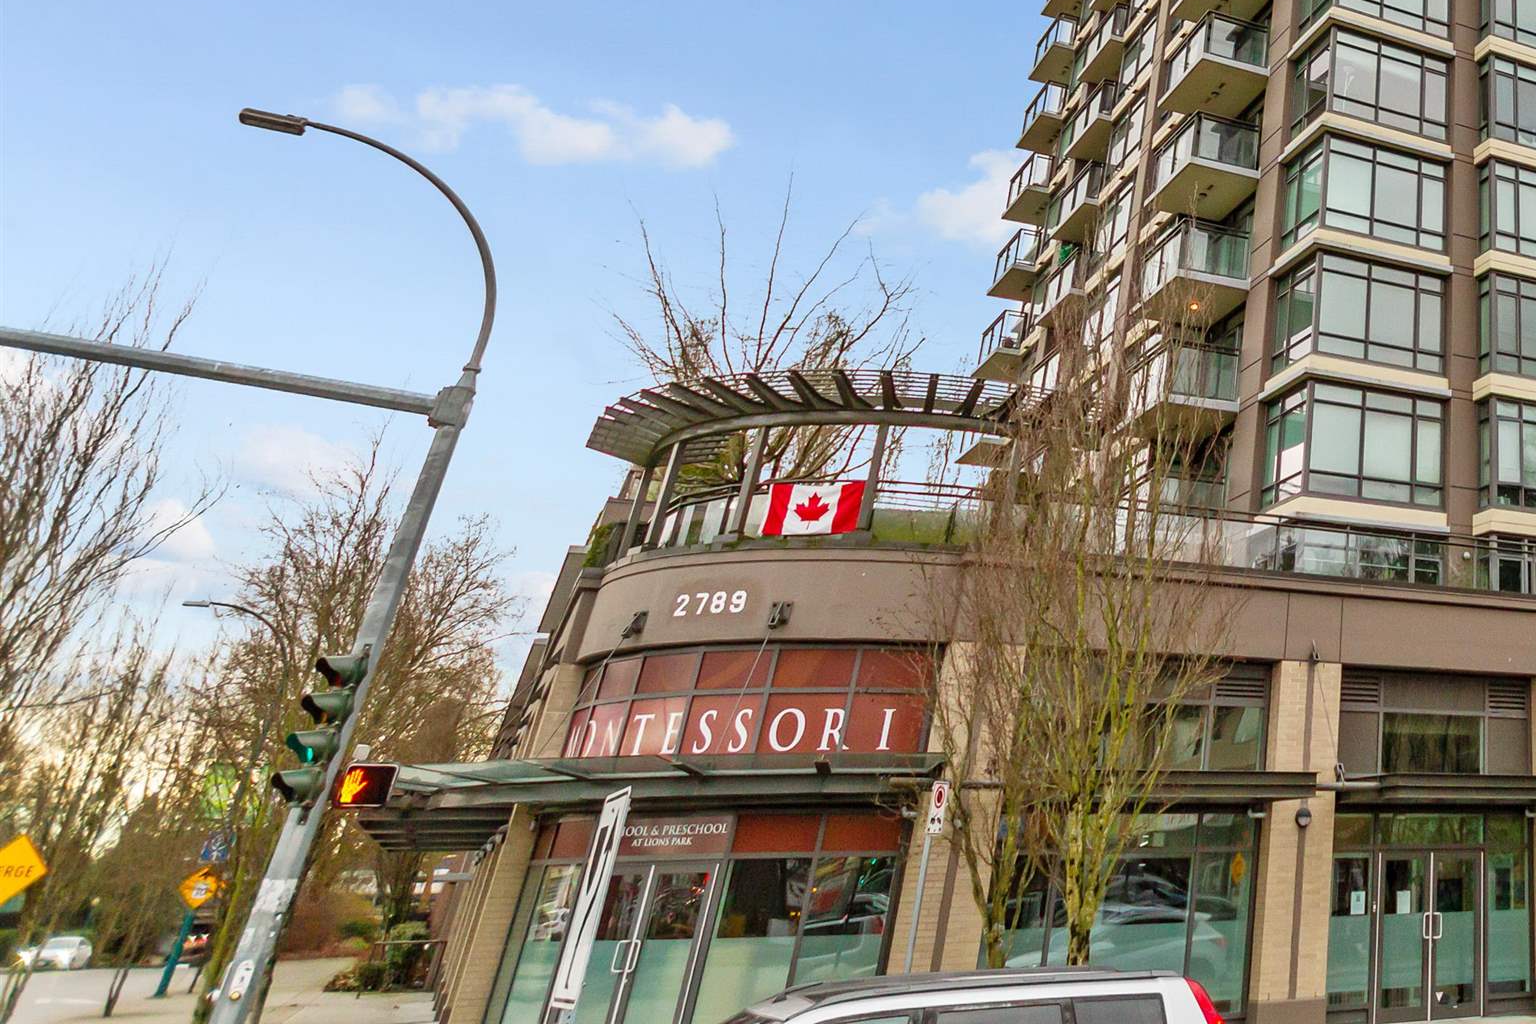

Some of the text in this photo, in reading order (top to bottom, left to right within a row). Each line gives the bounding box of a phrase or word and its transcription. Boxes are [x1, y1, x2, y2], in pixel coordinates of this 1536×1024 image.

[672, 590, 748, 617] 2789
[651, 824, 659, 836] &
[662, 822, 728, 836] PRESCHOOL
[631, 836, 693, 847] AT LIONS PARK
